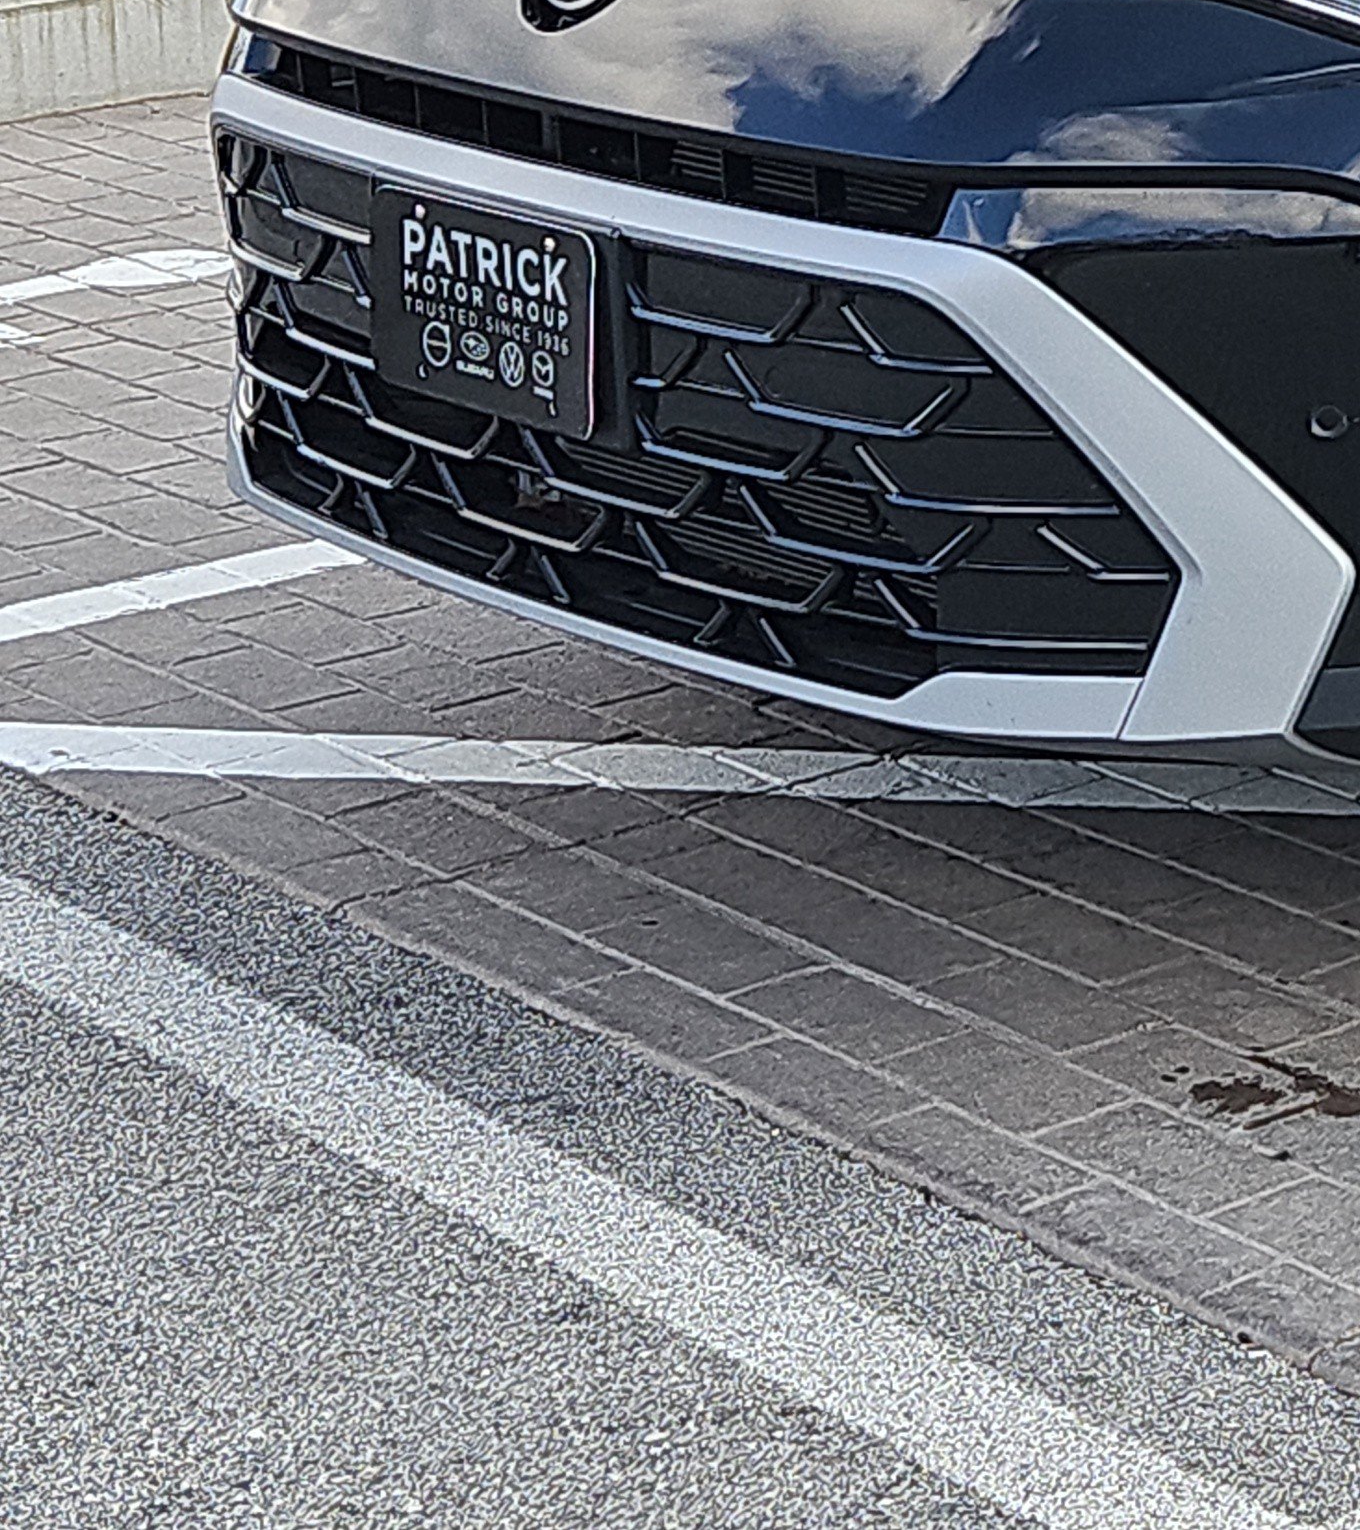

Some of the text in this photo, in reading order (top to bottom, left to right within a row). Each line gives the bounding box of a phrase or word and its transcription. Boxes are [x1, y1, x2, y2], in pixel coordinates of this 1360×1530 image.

[403, 219, 567, 306] PATRICK
[404, 269, 569, 332] MOTOR GROUP
[404, 295, 478, 329] TRUSTED
[486, 318, 531, 344] SINCE
